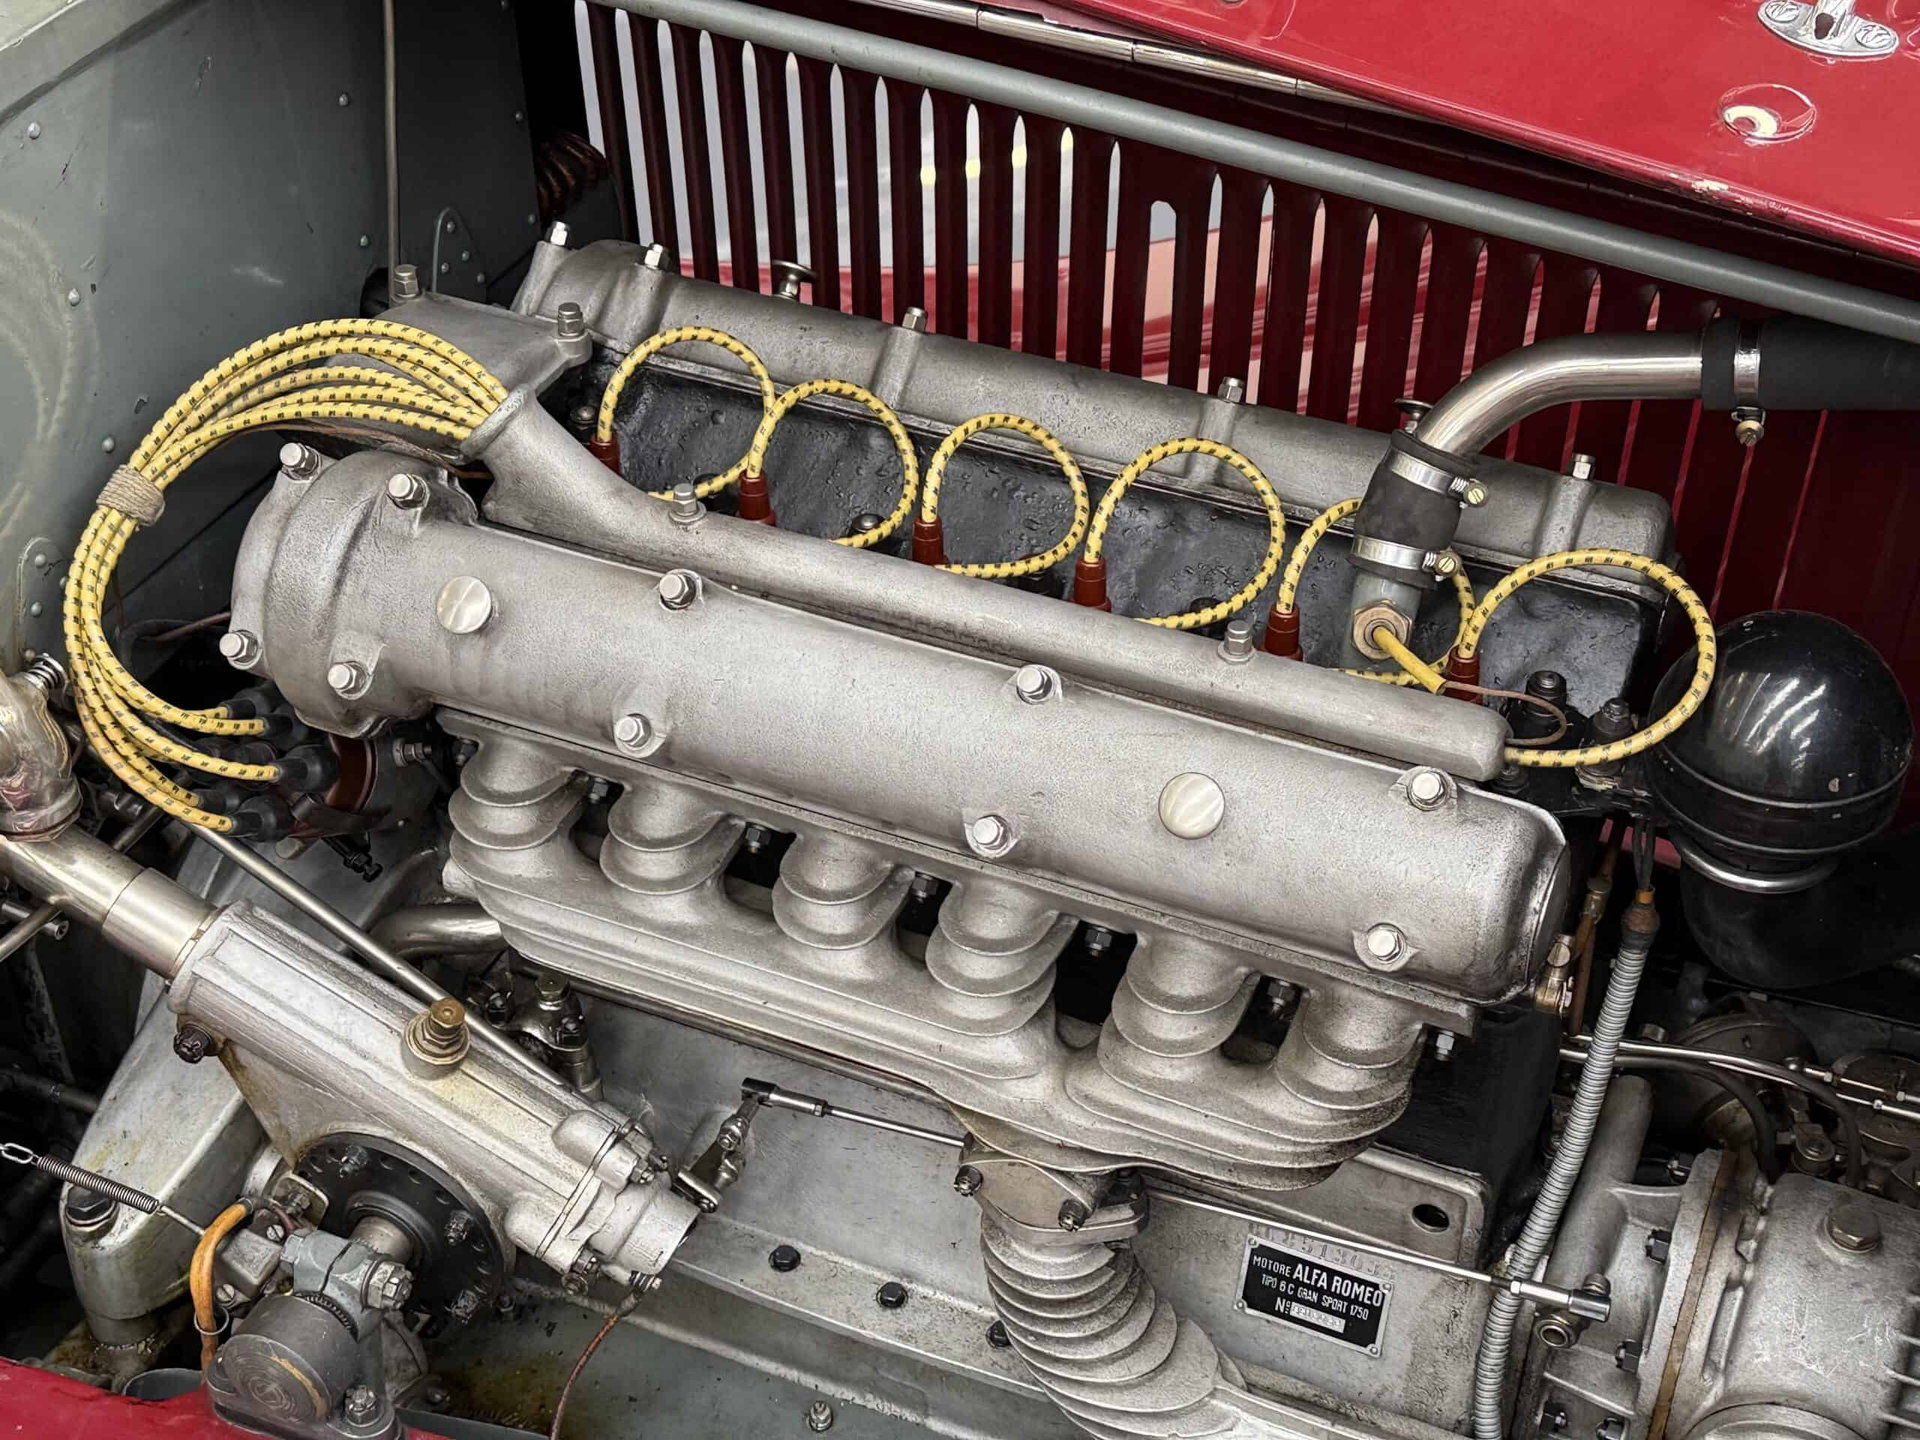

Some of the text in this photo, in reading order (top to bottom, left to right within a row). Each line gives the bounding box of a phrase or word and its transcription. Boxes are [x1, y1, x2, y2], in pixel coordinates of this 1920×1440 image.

[1253, 1255, 1382, 1307] MOTORE ALFA ROMEO
[1262, 1274, 1277, 1288] TIPO
[1280, 1281, 1286, 1292] 6
[1287, 1283, 1295, 1295] C
[1297, 1287, 1318, 1303] GRAN
[1321, 1295, 1348, 1313] SPORT
[1350, 1305, 1369, 1320] 1750
